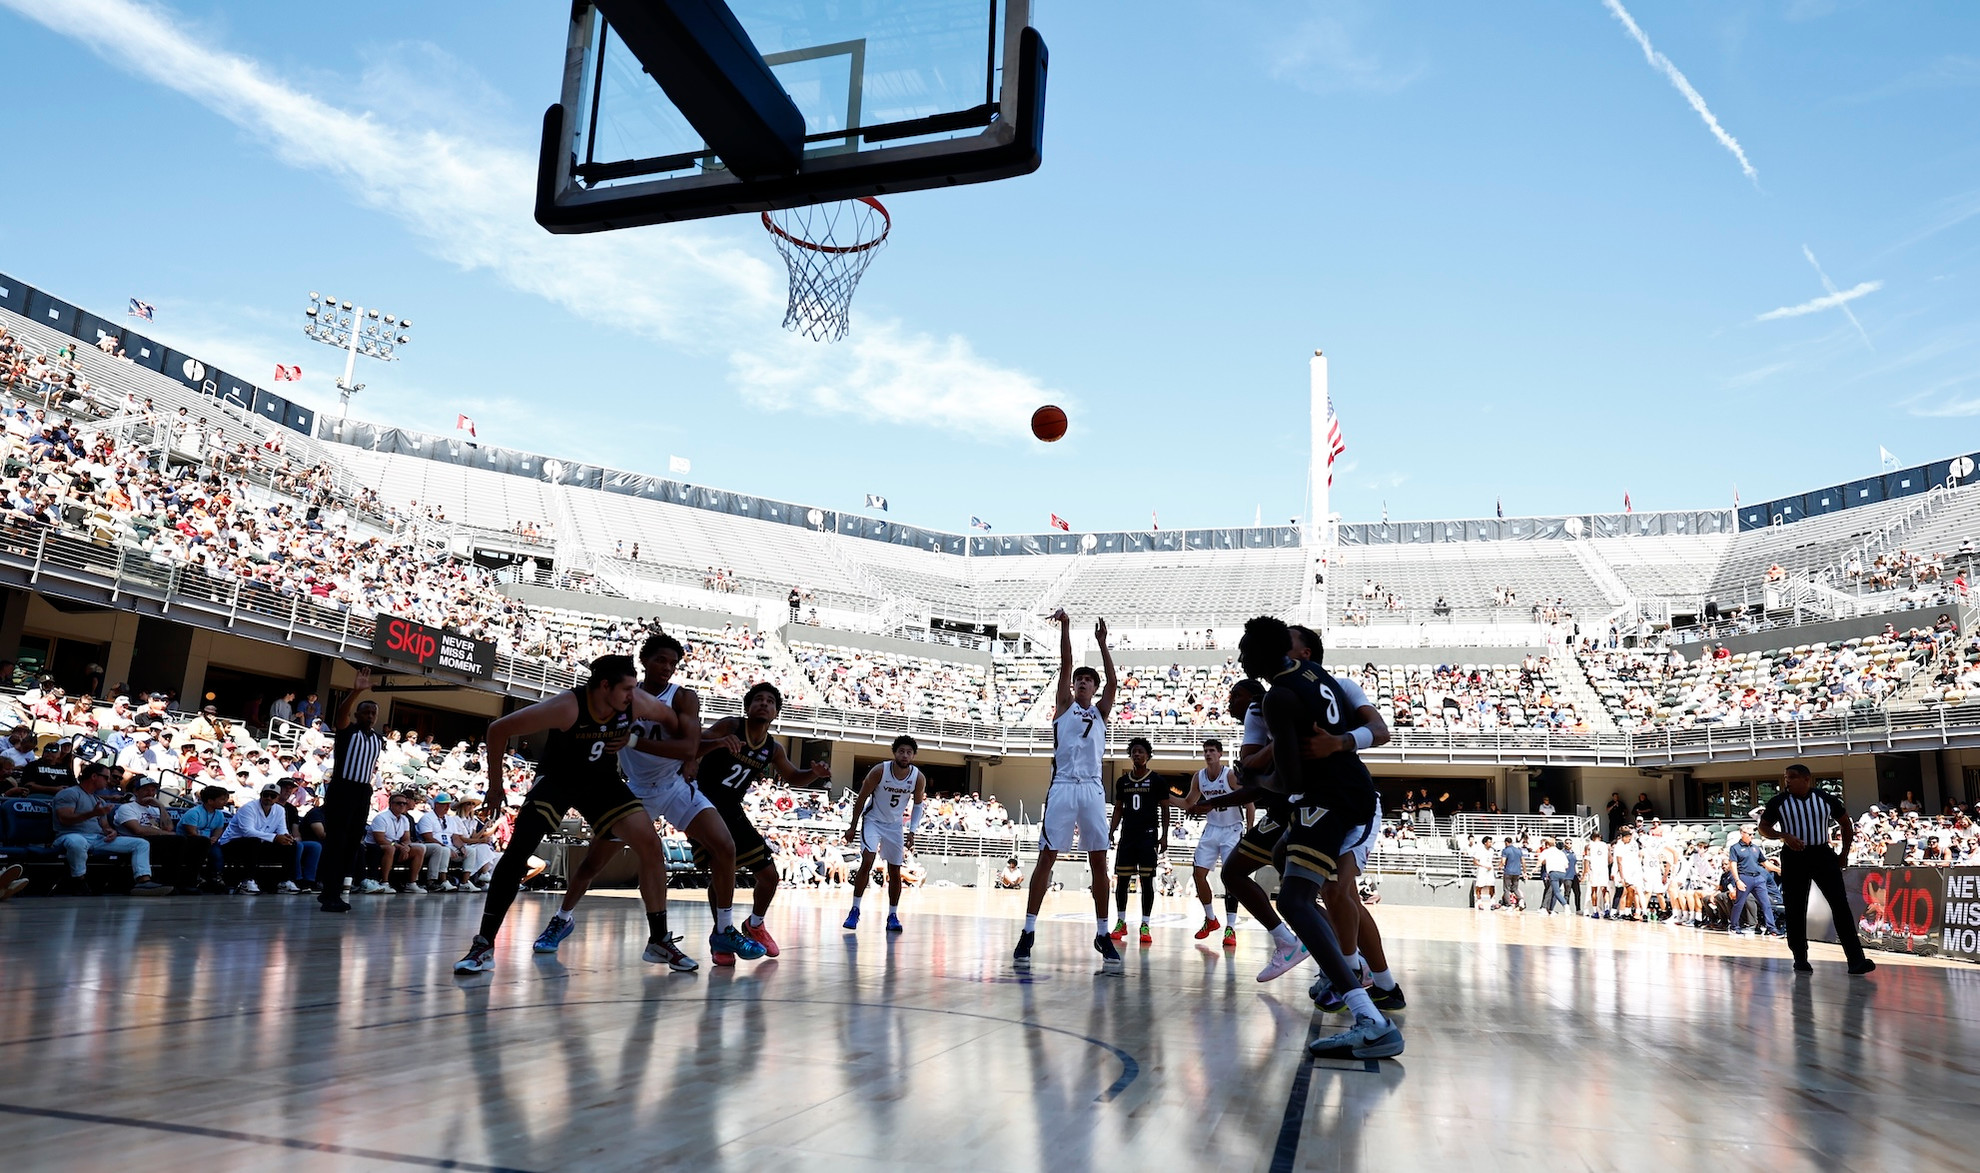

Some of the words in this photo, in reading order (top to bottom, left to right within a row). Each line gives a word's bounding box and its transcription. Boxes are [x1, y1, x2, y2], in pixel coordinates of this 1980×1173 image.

[386, 620, 436, 664] Skip
[442, 635, 475, 652] NEVER
[440, 645, 465, 660] MISS
[466, 652, 474, 662] A
[439, 655, 482, 675] MOMENT.
[1082, 718, 1093, 738] 7
[588, 741, 605, 761] 9
[722, 764, 751, 789] 21
[890, 794, 901, 808] 5
[1132, 794, 1140, 810] 0
[1861, 869, 1934, 952] Skip
